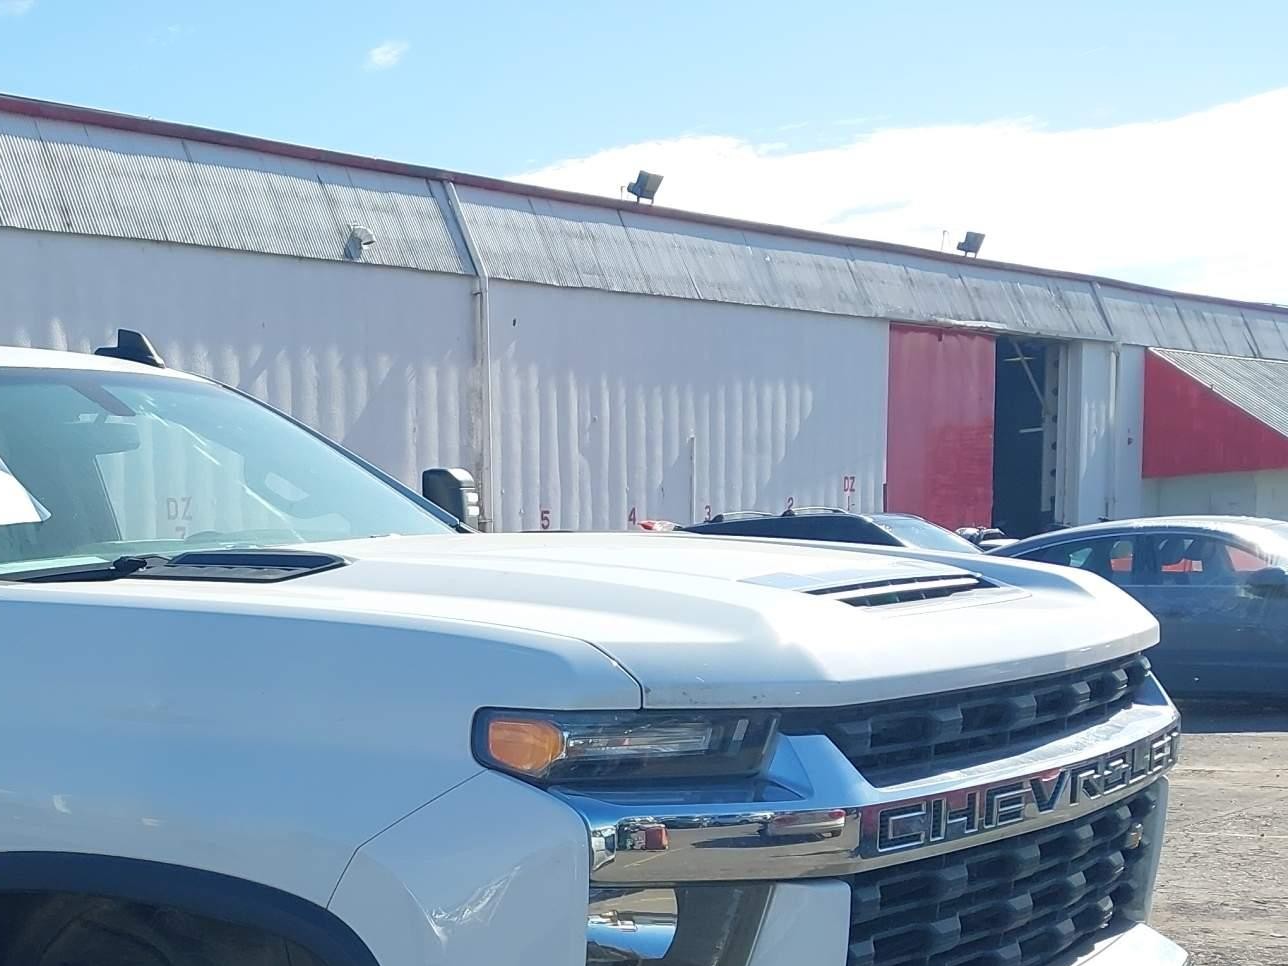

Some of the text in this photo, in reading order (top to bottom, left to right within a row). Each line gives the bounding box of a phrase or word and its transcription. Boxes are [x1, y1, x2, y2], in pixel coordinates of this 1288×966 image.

[167, 496, 192, 520] DZ
[628, 507, 637, 525] 4
[540, 510, 551, 529] 5
[877, 731, 1179, 852] CHEVROLET
